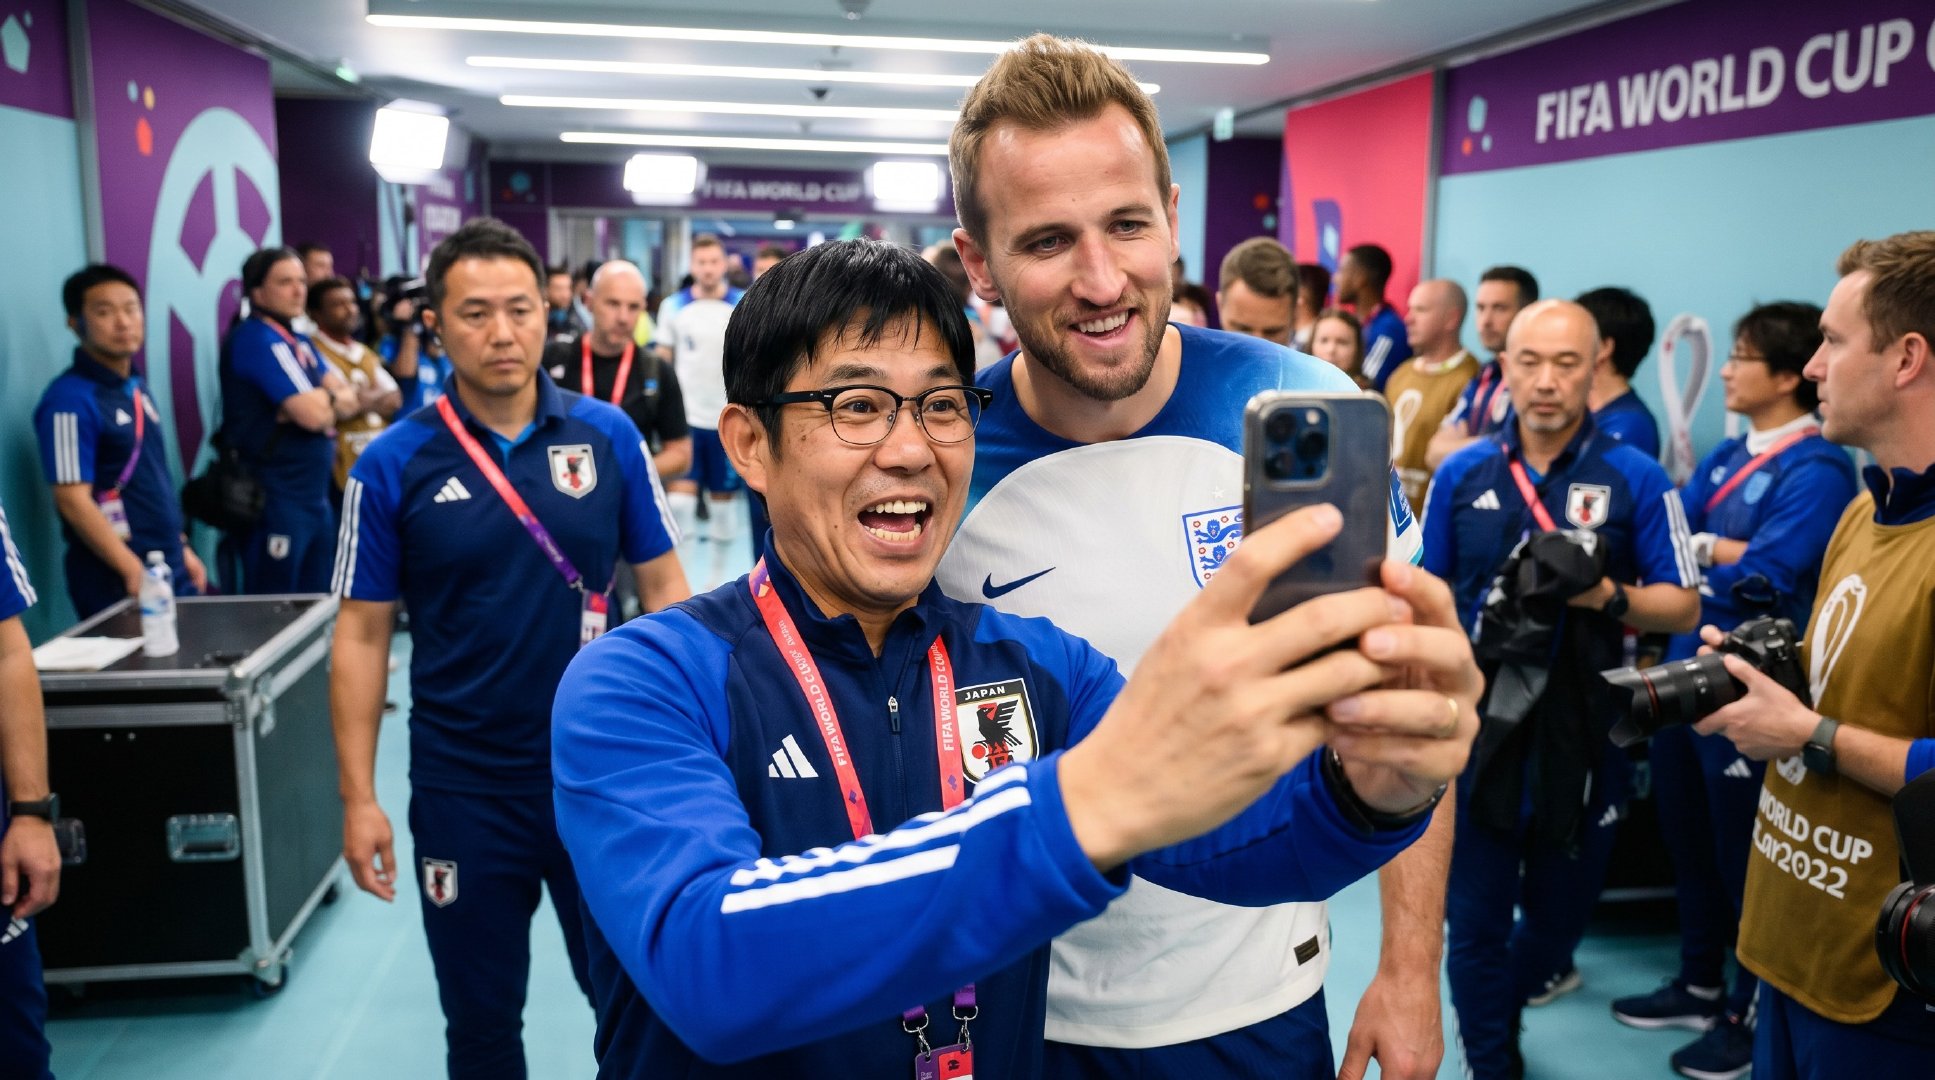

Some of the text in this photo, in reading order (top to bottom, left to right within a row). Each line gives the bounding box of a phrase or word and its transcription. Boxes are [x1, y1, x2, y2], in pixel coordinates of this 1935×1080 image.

[1535, 81, 1614, 143] FIFA
[1618, 46, 1786, 129] WORLD
[1795, 18, 1915, 99] CUP
[748, 181, 822, 202] WORLD
[937, 674, 952, 721] WORLD
[964, 685, 1006, 701] JAPAN
[809, 684, 848, 766] FIFA WORLD
[942, 722, 955, 751] FIFA
[1758, 784, 1873, 866] WORLD CUP
